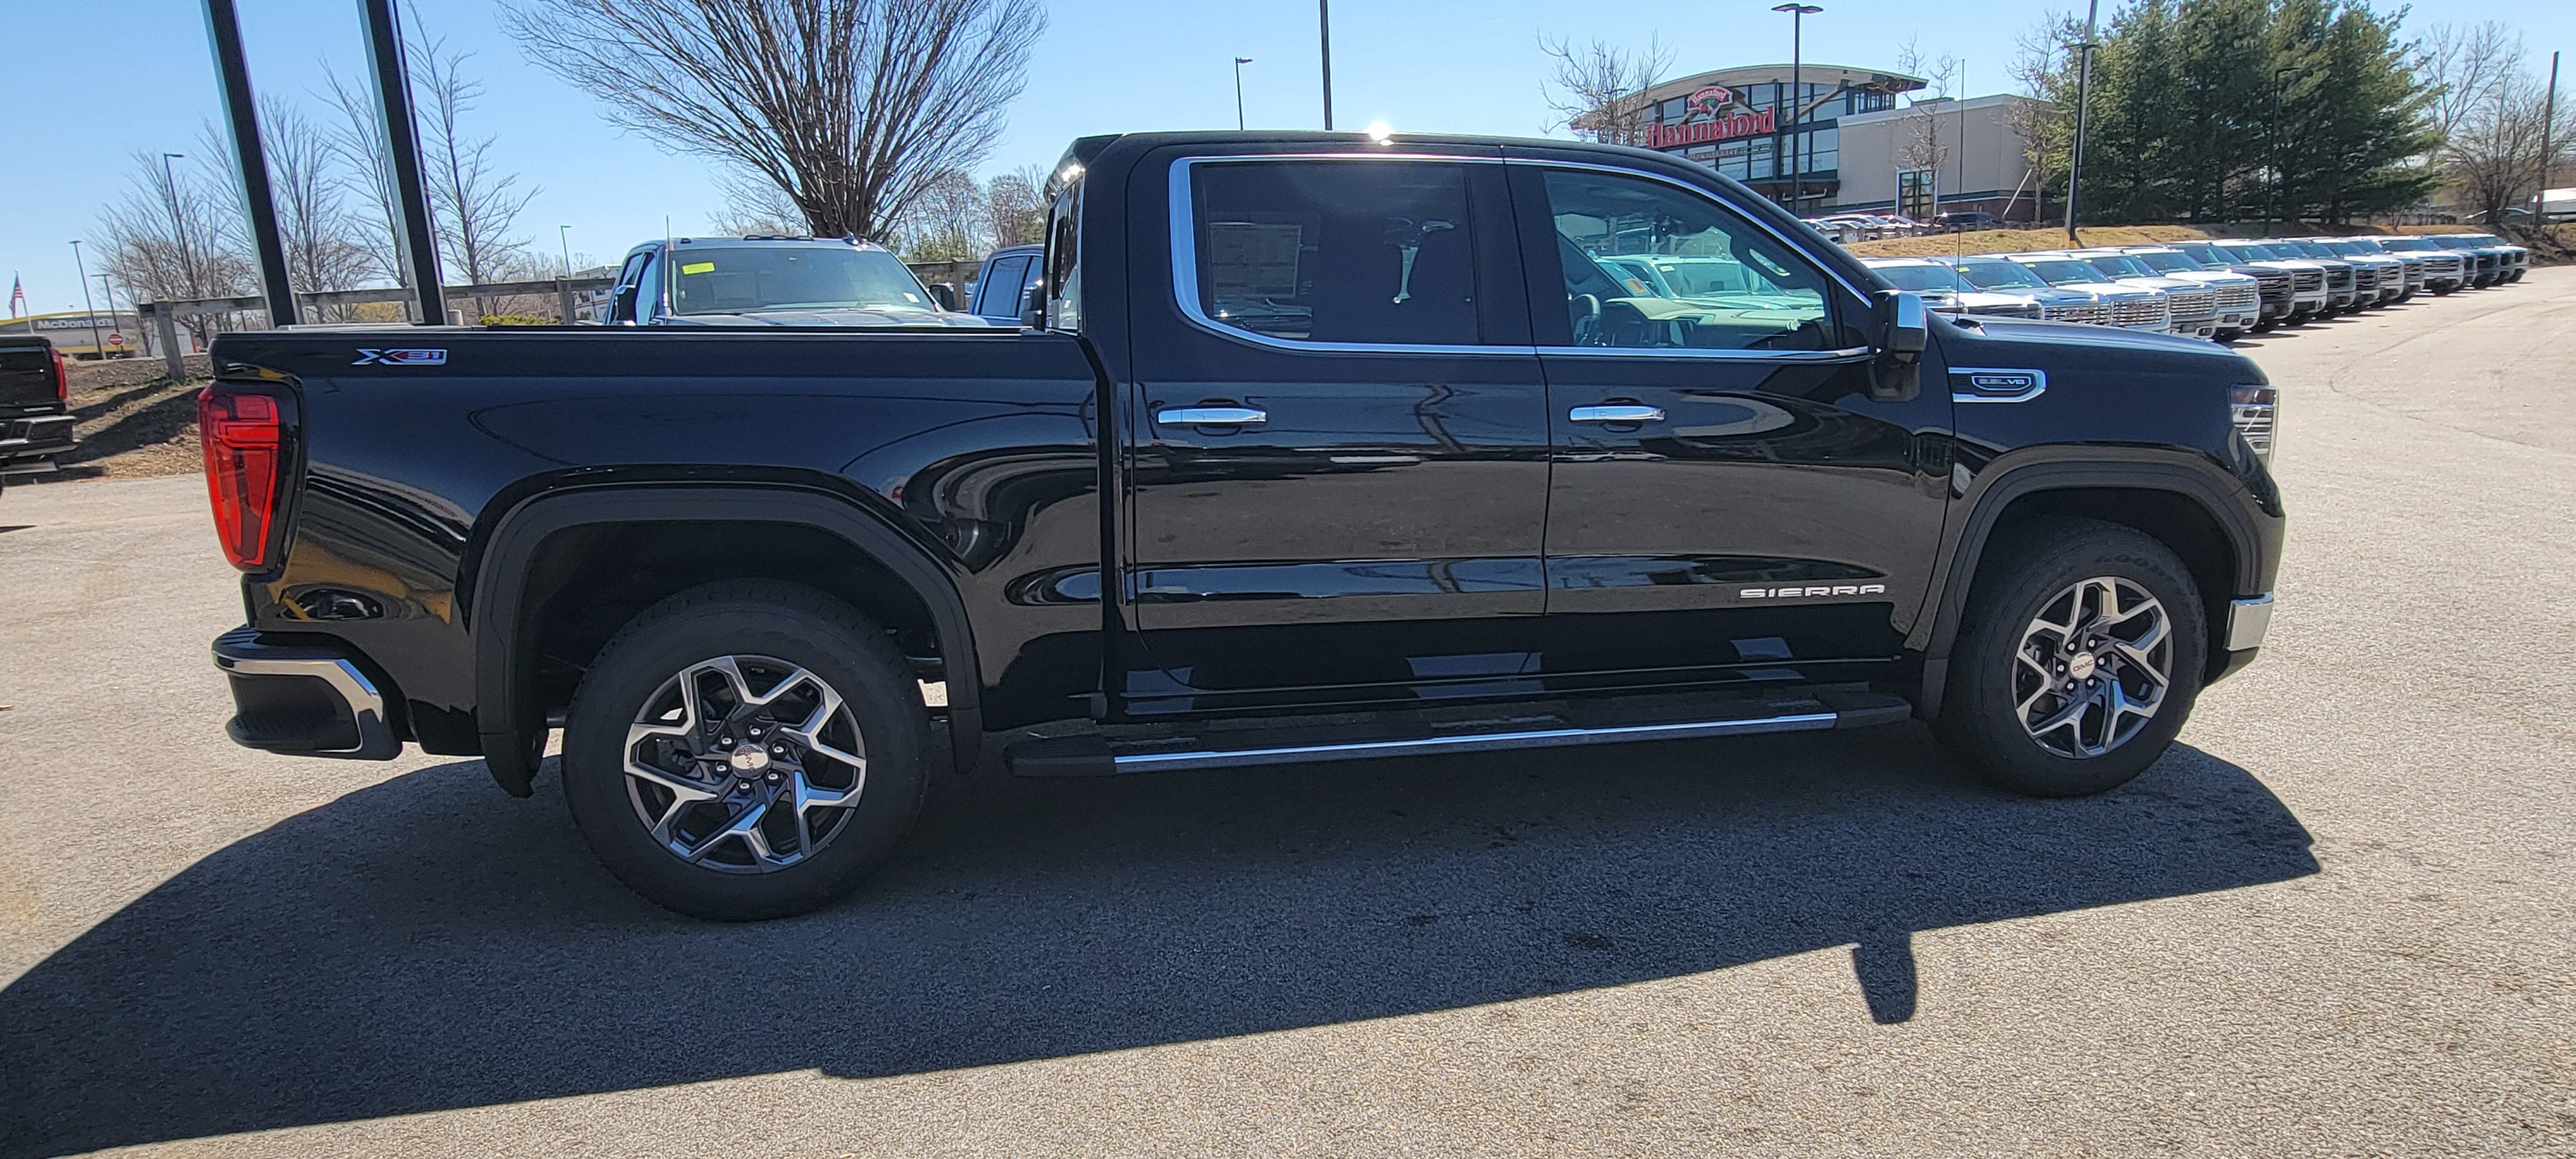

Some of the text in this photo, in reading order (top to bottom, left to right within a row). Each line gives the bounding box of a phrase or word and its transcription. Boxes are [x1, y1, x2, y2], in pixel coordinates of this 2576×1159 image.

[1647, 106, 1776, 149] Hannaford
[1739, 584, 1886, 599] SIERRA
[2072, 660, 2094, 672] GMC
[743, 748, 756, 775] GMC
